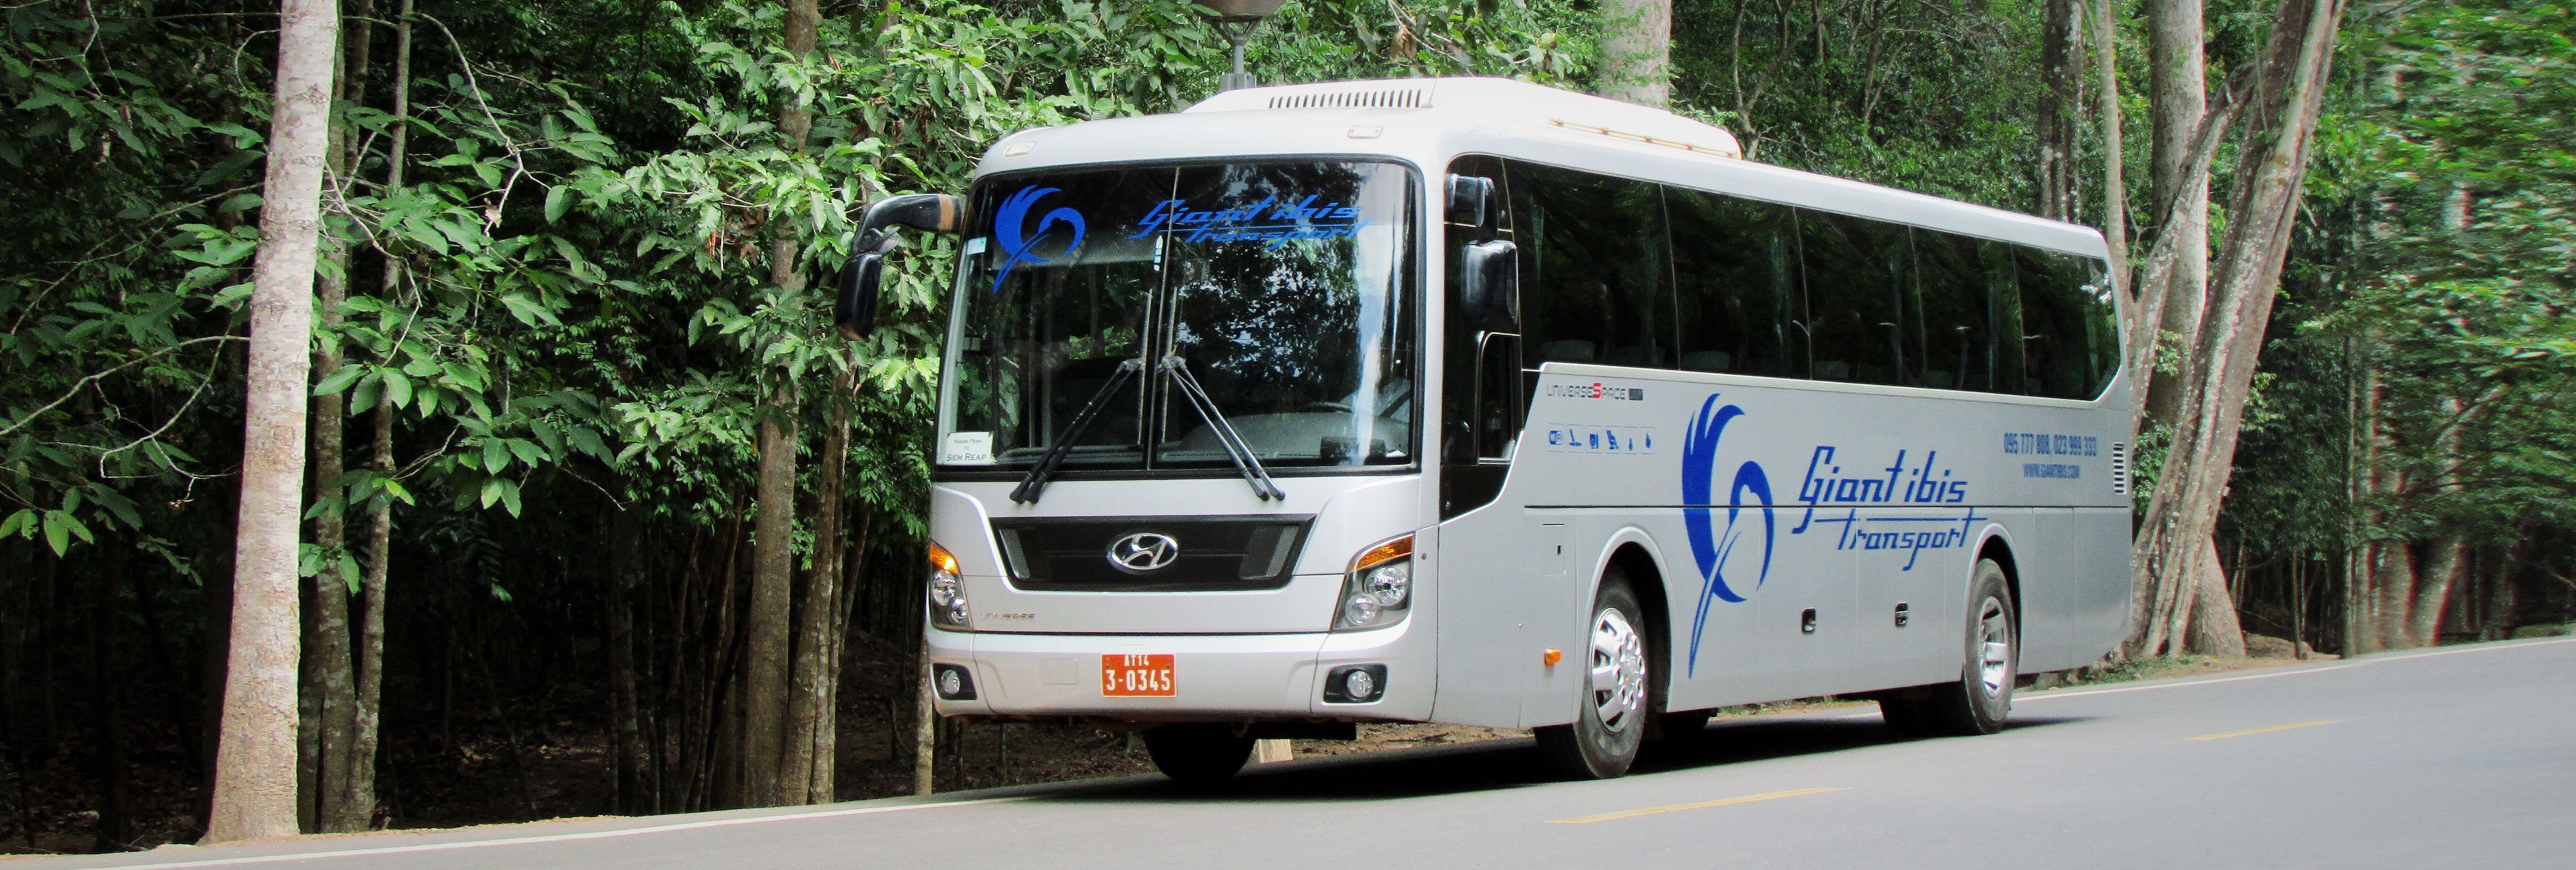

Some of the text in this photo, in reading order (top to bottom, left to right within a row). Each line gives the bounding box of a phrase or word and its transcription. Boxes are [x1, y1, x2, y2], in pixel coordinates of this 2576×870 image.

[1127, 194, 1361, 239] Giant ibis
[2004, 433, 2018, 454] 095
[2020, 434, 2033, 455] 777
[2054, 434, 2067, 455] 023
[1791, 445, 1968, 534] Giant ibis
[1124, 655, 1149, 667] AT14
[1106, 669, 1171, 692] 3-0345
